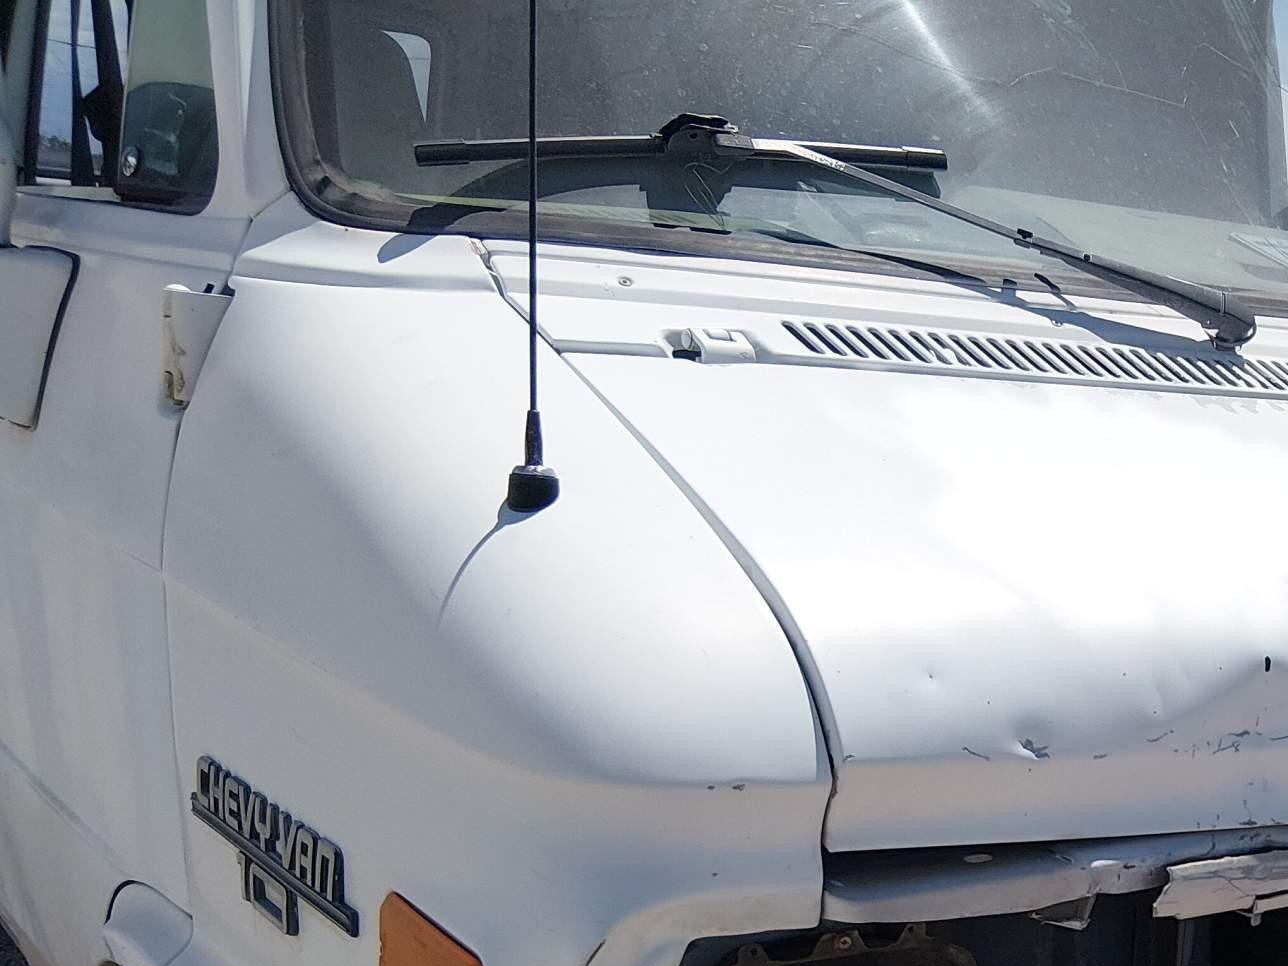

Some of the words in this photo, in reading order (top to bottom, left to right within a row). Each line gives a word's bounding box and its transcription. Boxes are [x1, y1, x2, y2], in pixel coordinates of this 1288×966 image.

[196, 756, 275, 853] CHEVY
[276, 811, 344, 903] VAN
[236, 850, 298, 936] 10
